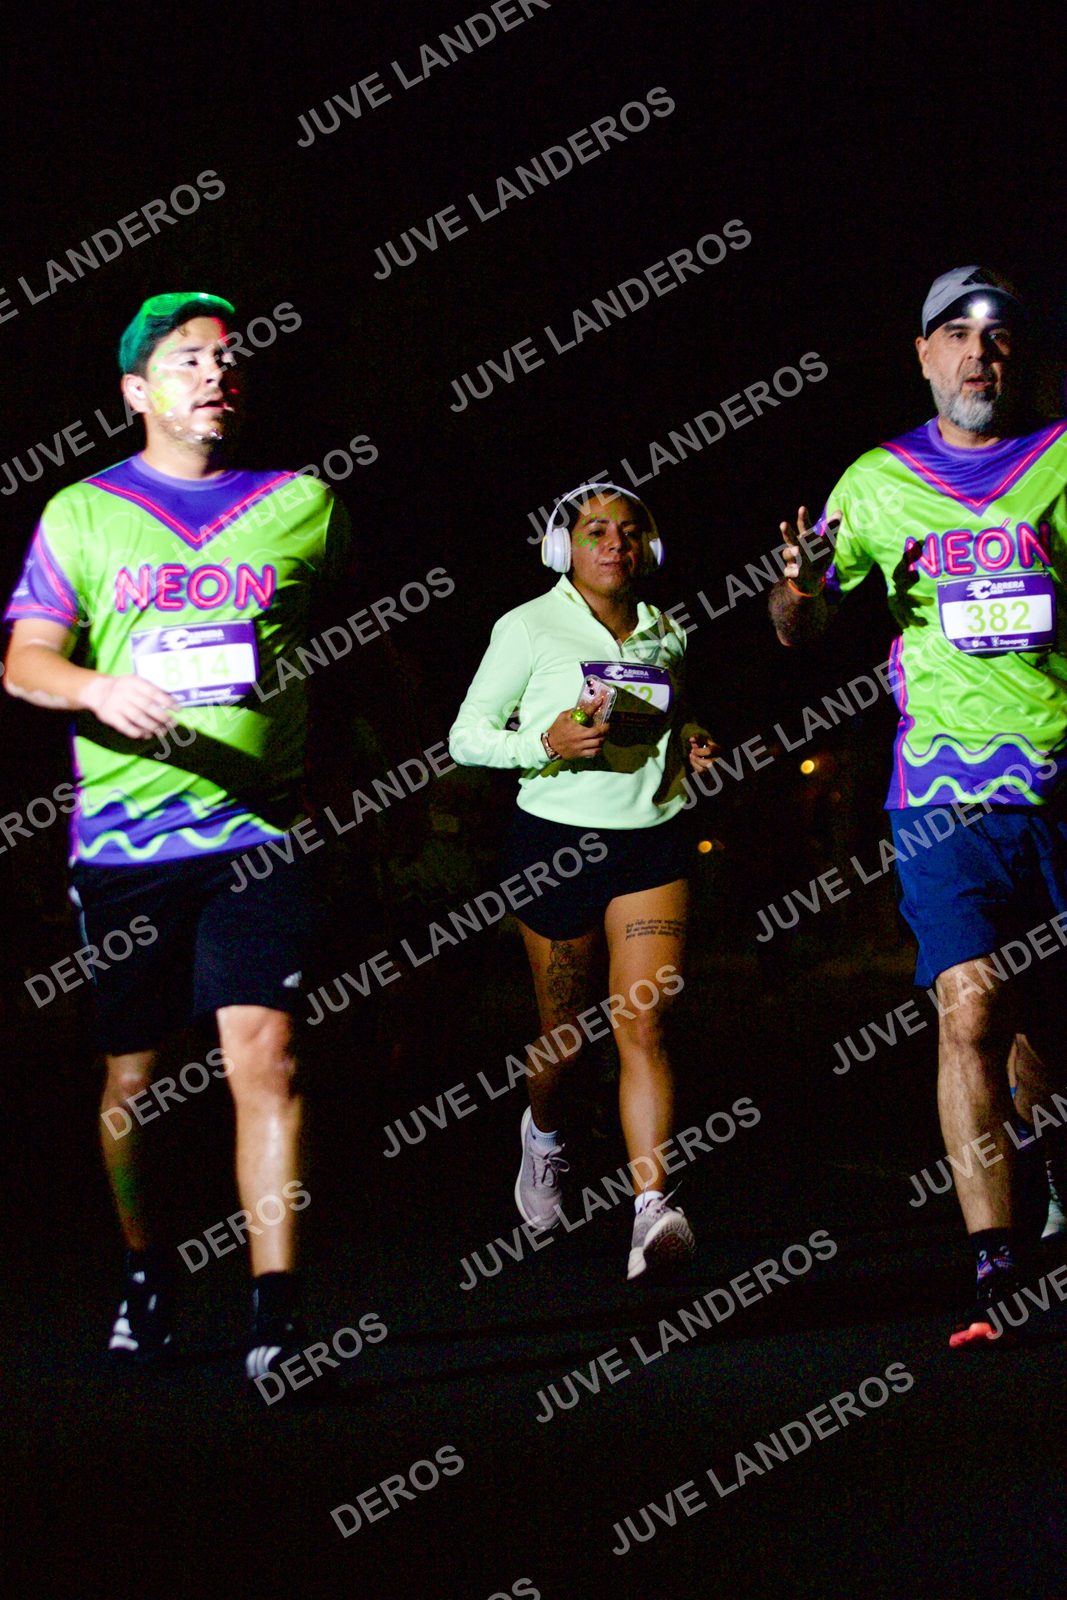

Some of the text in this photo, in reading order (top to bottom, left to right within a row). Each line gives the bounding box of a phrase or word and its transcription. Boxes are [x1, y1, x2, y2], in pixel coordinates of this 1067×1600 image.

[905, 518, 1053, 578] NEÓN
[115, 558, 276, 613] NEÓN
[966, 601, 1032, 633] 382
[164, 652, 231, 686] 814
